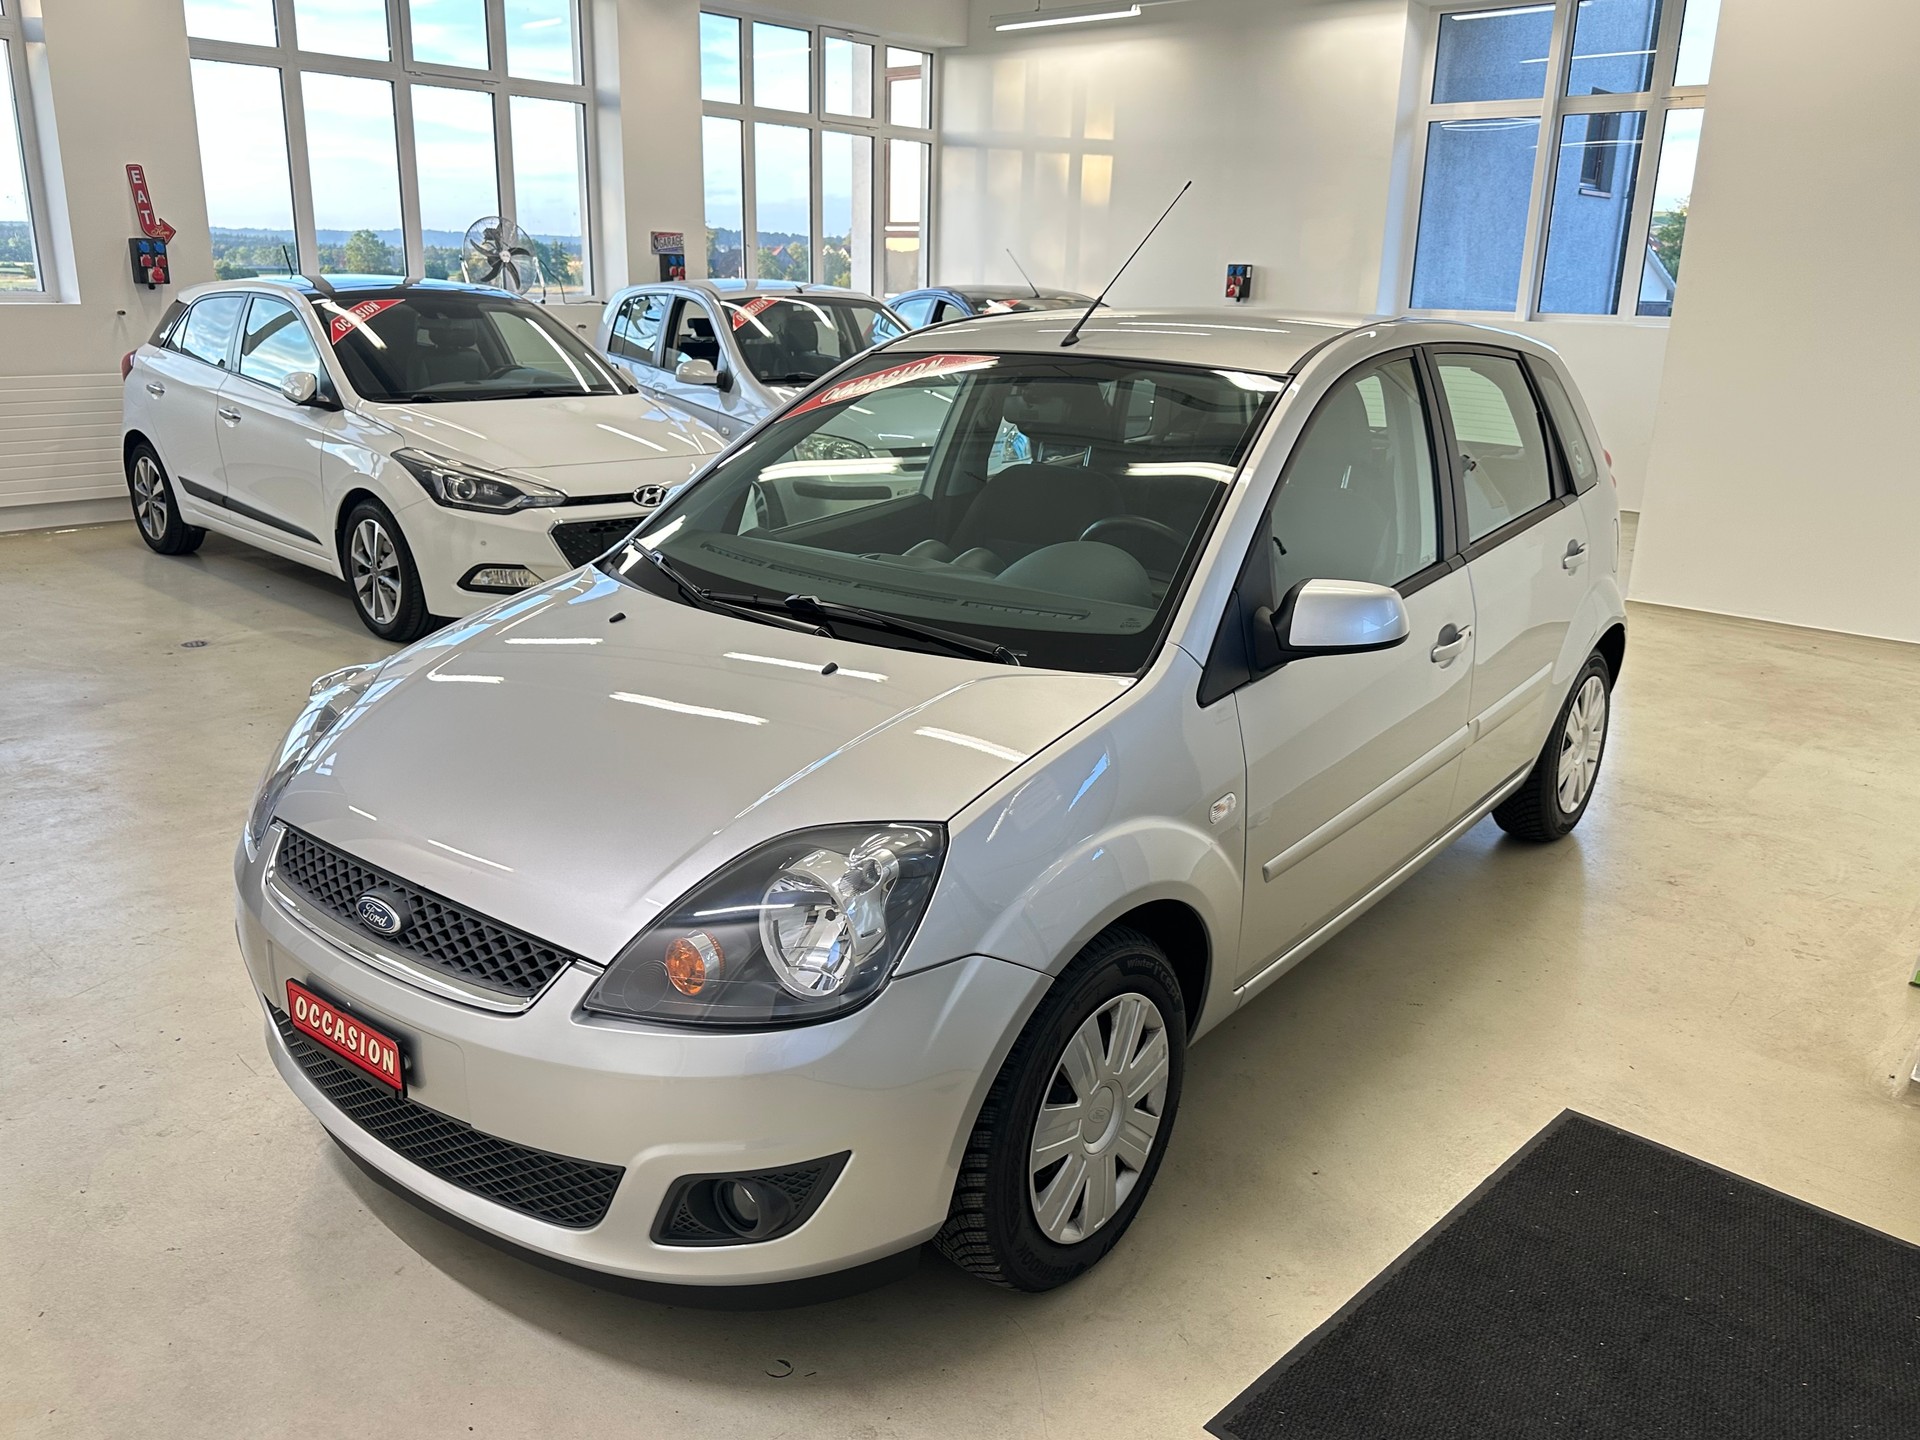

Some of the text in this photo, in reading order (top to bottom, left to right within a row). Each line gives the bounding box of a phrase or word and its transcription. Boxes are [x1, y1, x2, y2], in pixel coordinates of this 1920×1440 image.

[130, 170, 151, 225] EAT
[659, 235, 684, 249] GARAGE
[334, 301, 381, 332] OCSION
[362, 902, 388, 928] Ford
[1126, 958, 1155, 970] Winter
[295, 995, 395, 1075] OCCASION
